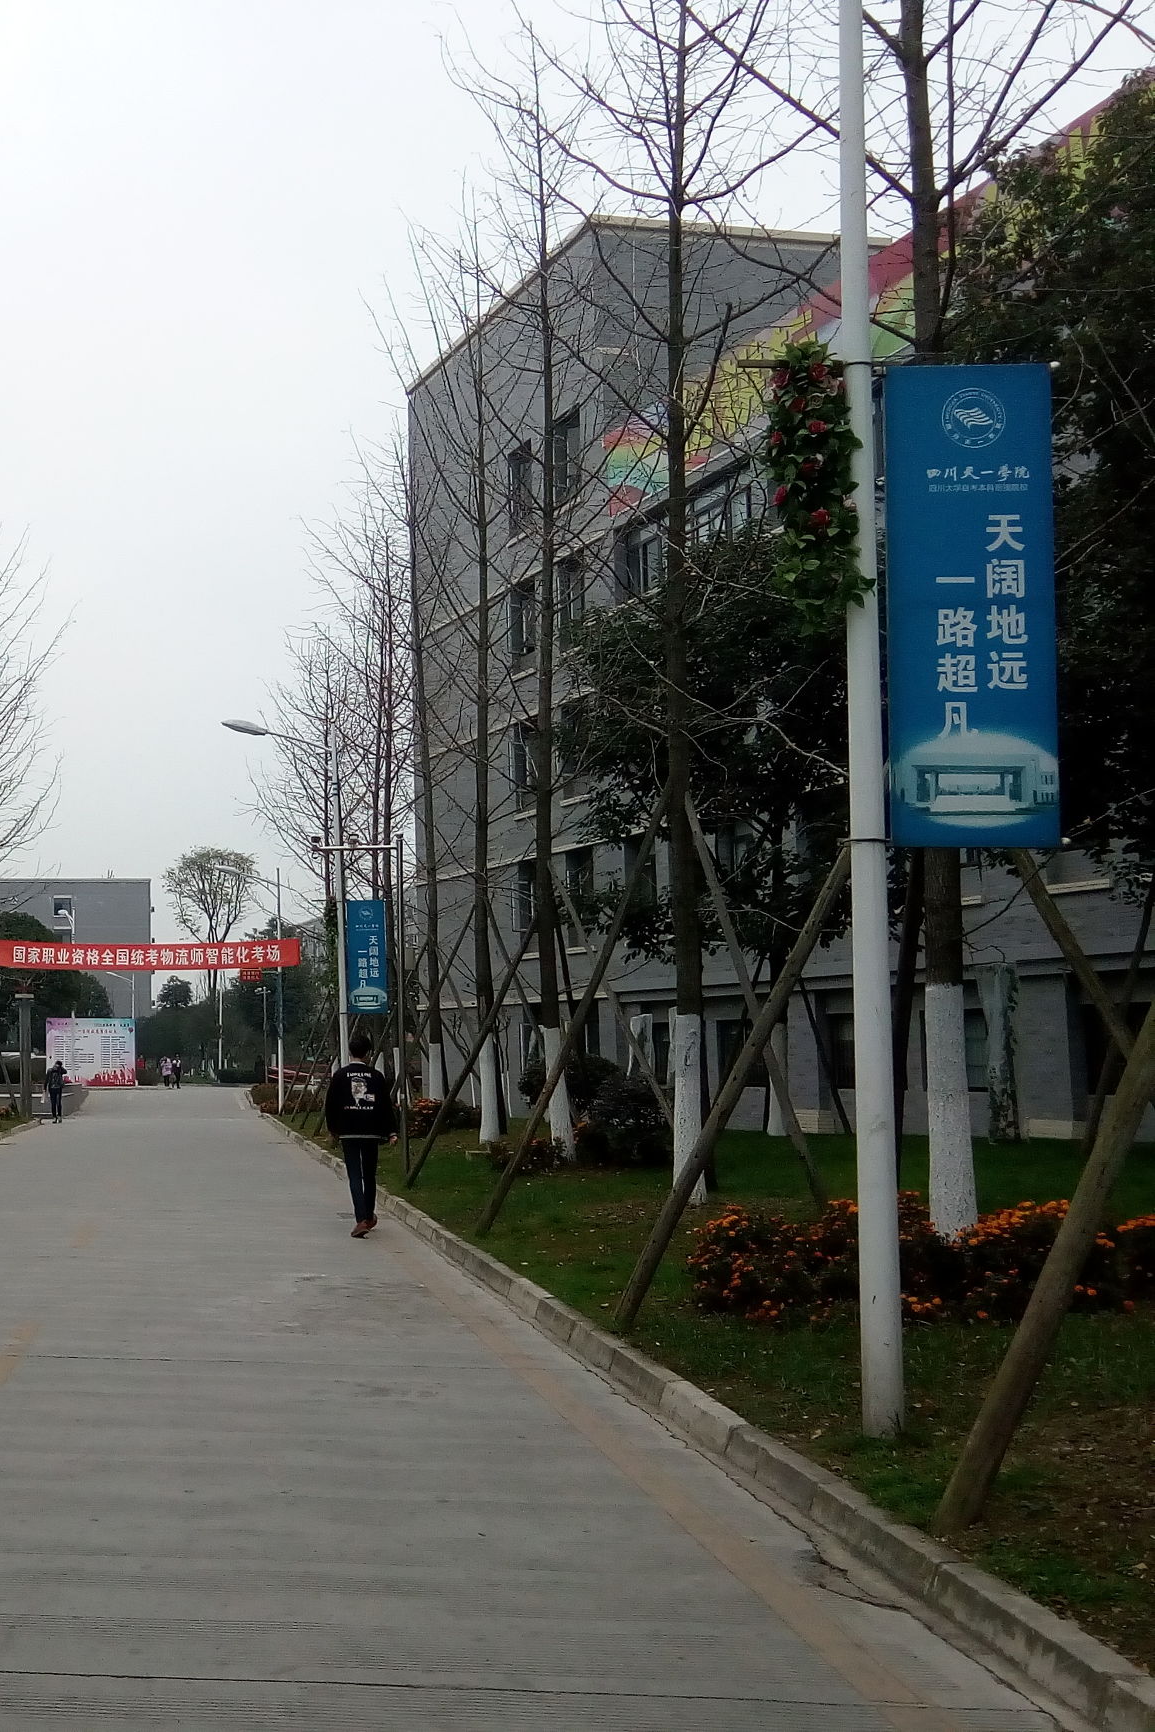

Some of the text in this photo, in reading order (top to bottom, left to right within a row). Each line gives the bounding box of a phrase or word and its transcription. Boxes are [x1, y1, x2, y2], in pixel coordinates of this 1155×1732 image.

[935, 574, 979, 739] 一路超凡
[985, 513, 1029, 692] 天阔地远
[12, 944, 281, 966] 国家职业资格全国统考物流师智能化考场
